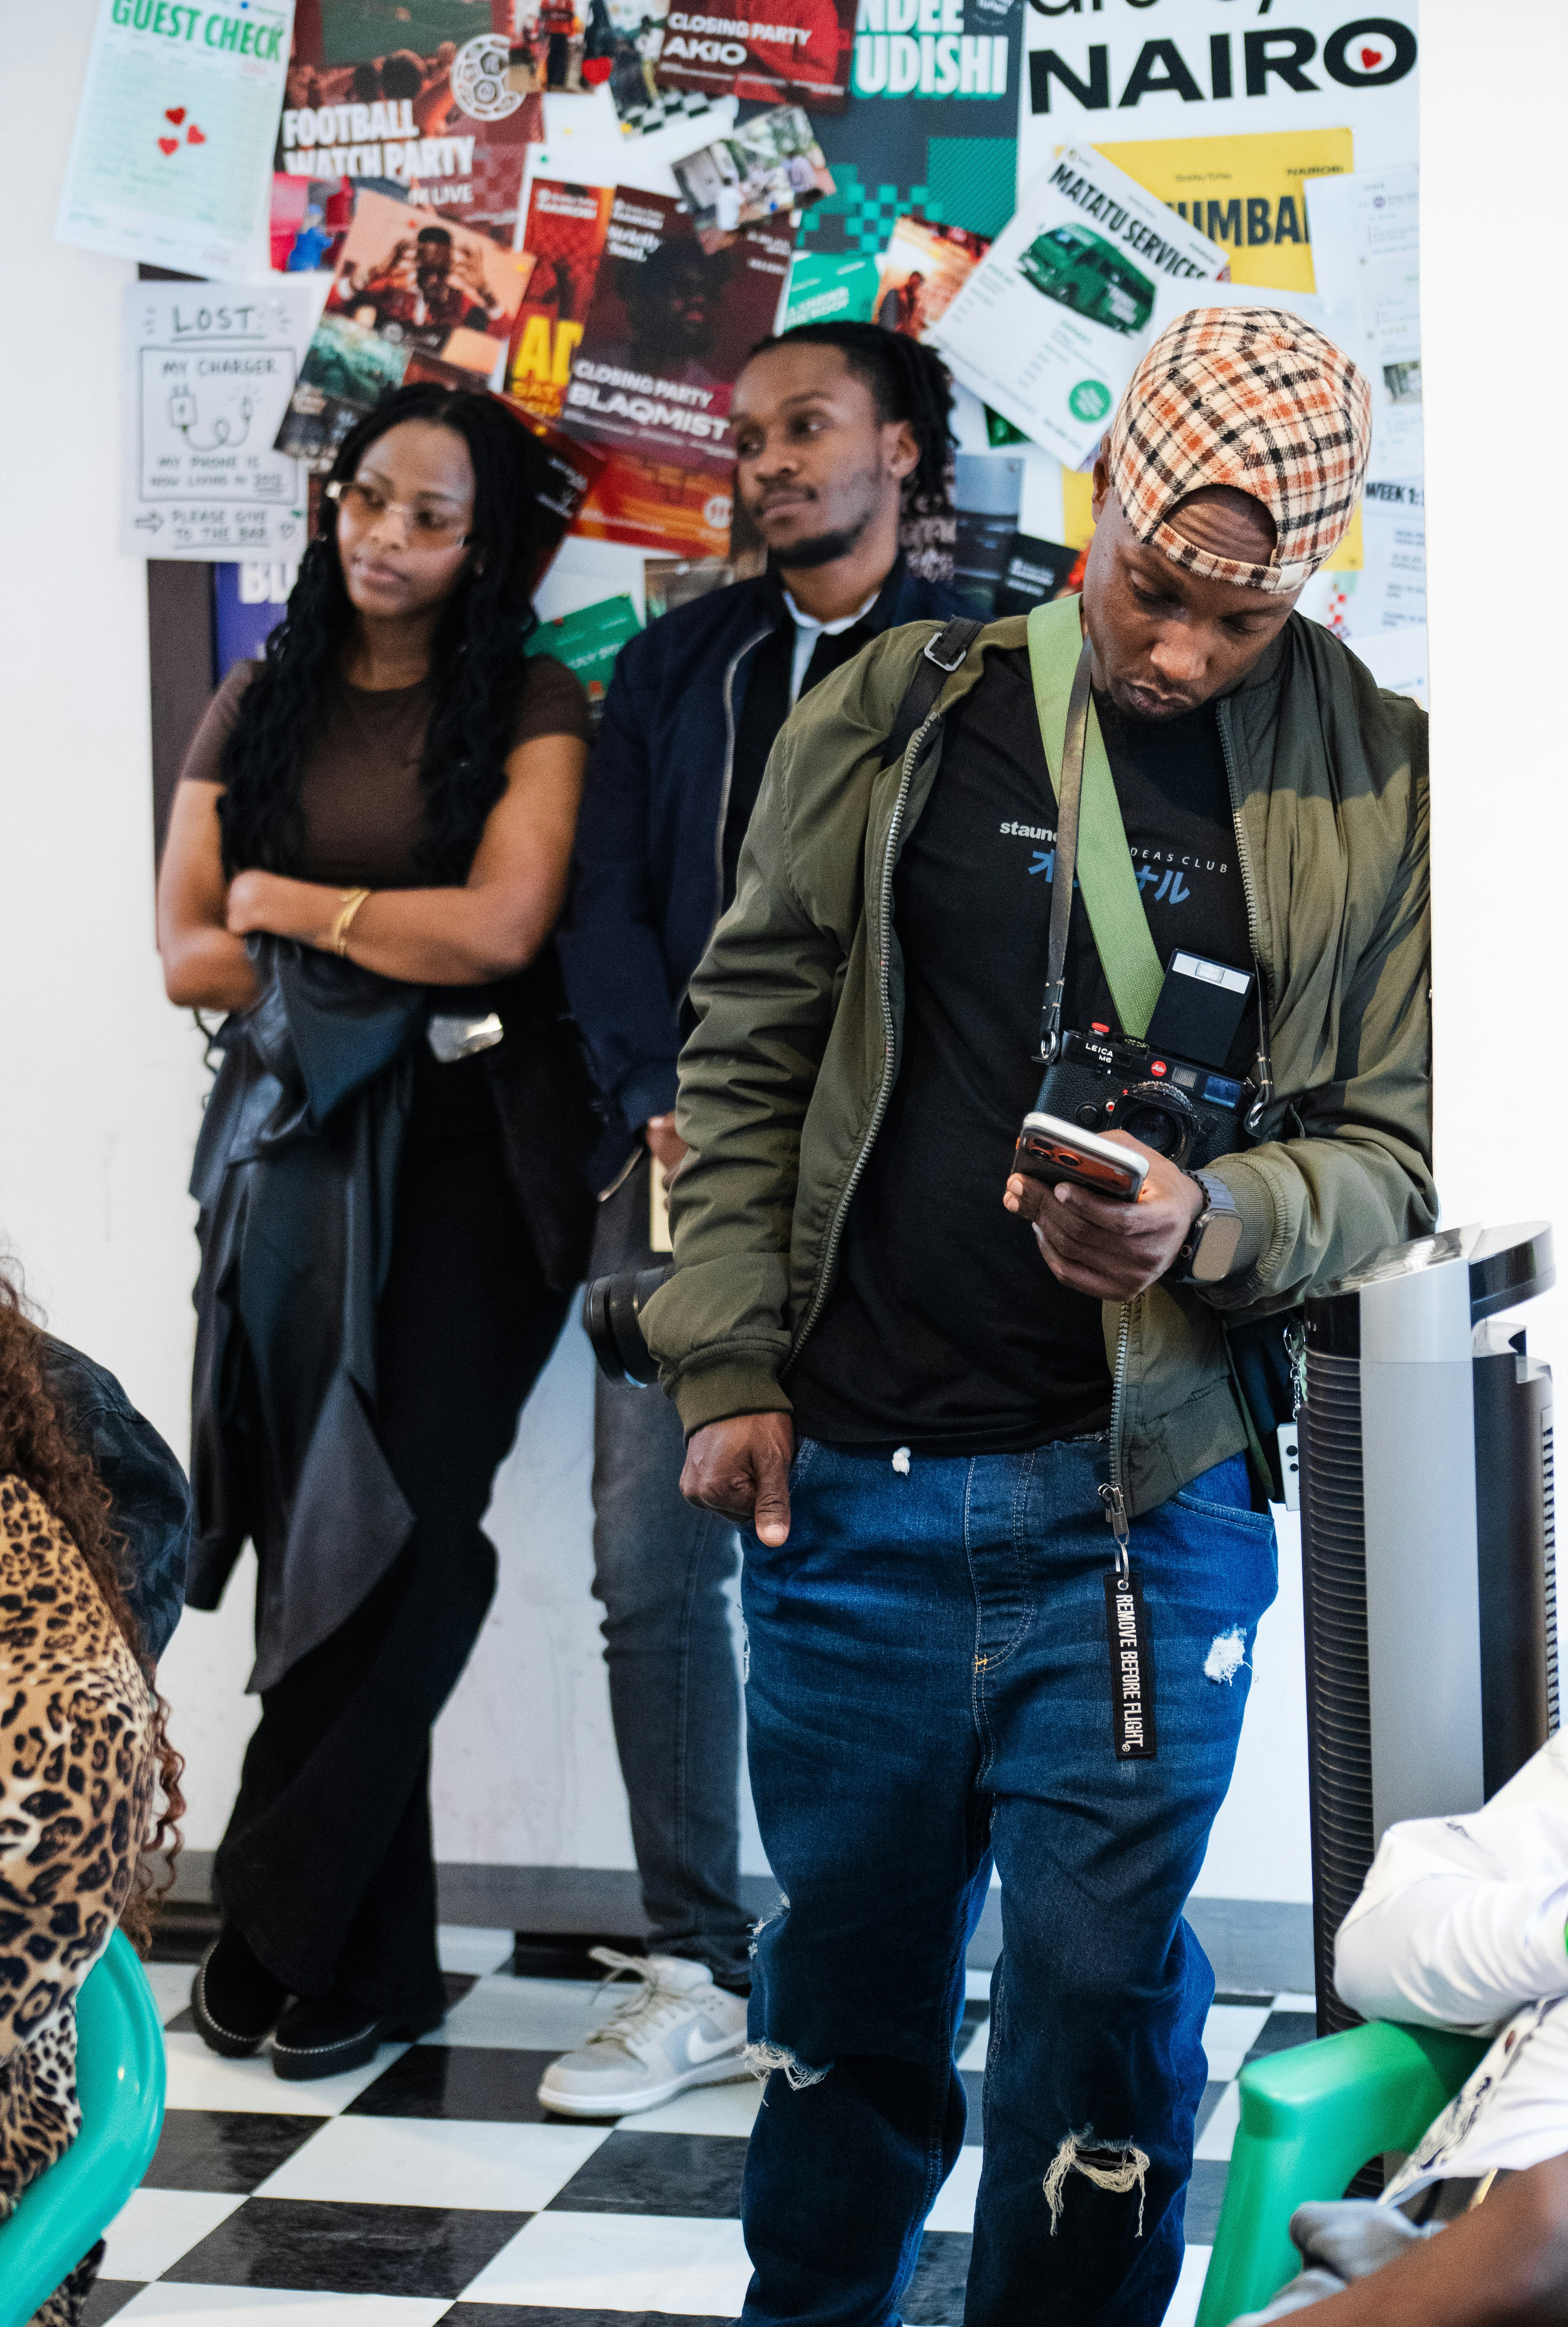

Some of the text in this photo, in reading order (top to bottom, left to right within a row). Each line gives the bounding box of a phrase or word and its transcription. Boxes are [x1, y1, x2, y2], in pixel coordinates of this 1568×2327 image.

[112, 0, 284, 62] GUEST CHECK
[662, 36, 747, 66] AKIO
[668, 12, 813, 46] CLOSING PARTY
[854, 34, 1009, 94] UDISHI
[1028, 17, 1418, 115] NAIRO
[283, 98, 420, 149] FOOTBALL
[283, 135, 475, 180] WATCH PARTY
[1047, 162, 1126, 234] MATATU
[572, 358, 714, 409] CLOSING PARTY
[567, 380, 730, 441] BLAQMIST
[1365, 481, 1405, 504] WEEK
[1000, 822, 1057, 842] staun
[1085, 1043, 1113, 1057] LEICA
[1099, 1055, 1112, 1063] M6
[1116, 1594, 1143, 1747] REMOVE BEFORE FLIGHT
